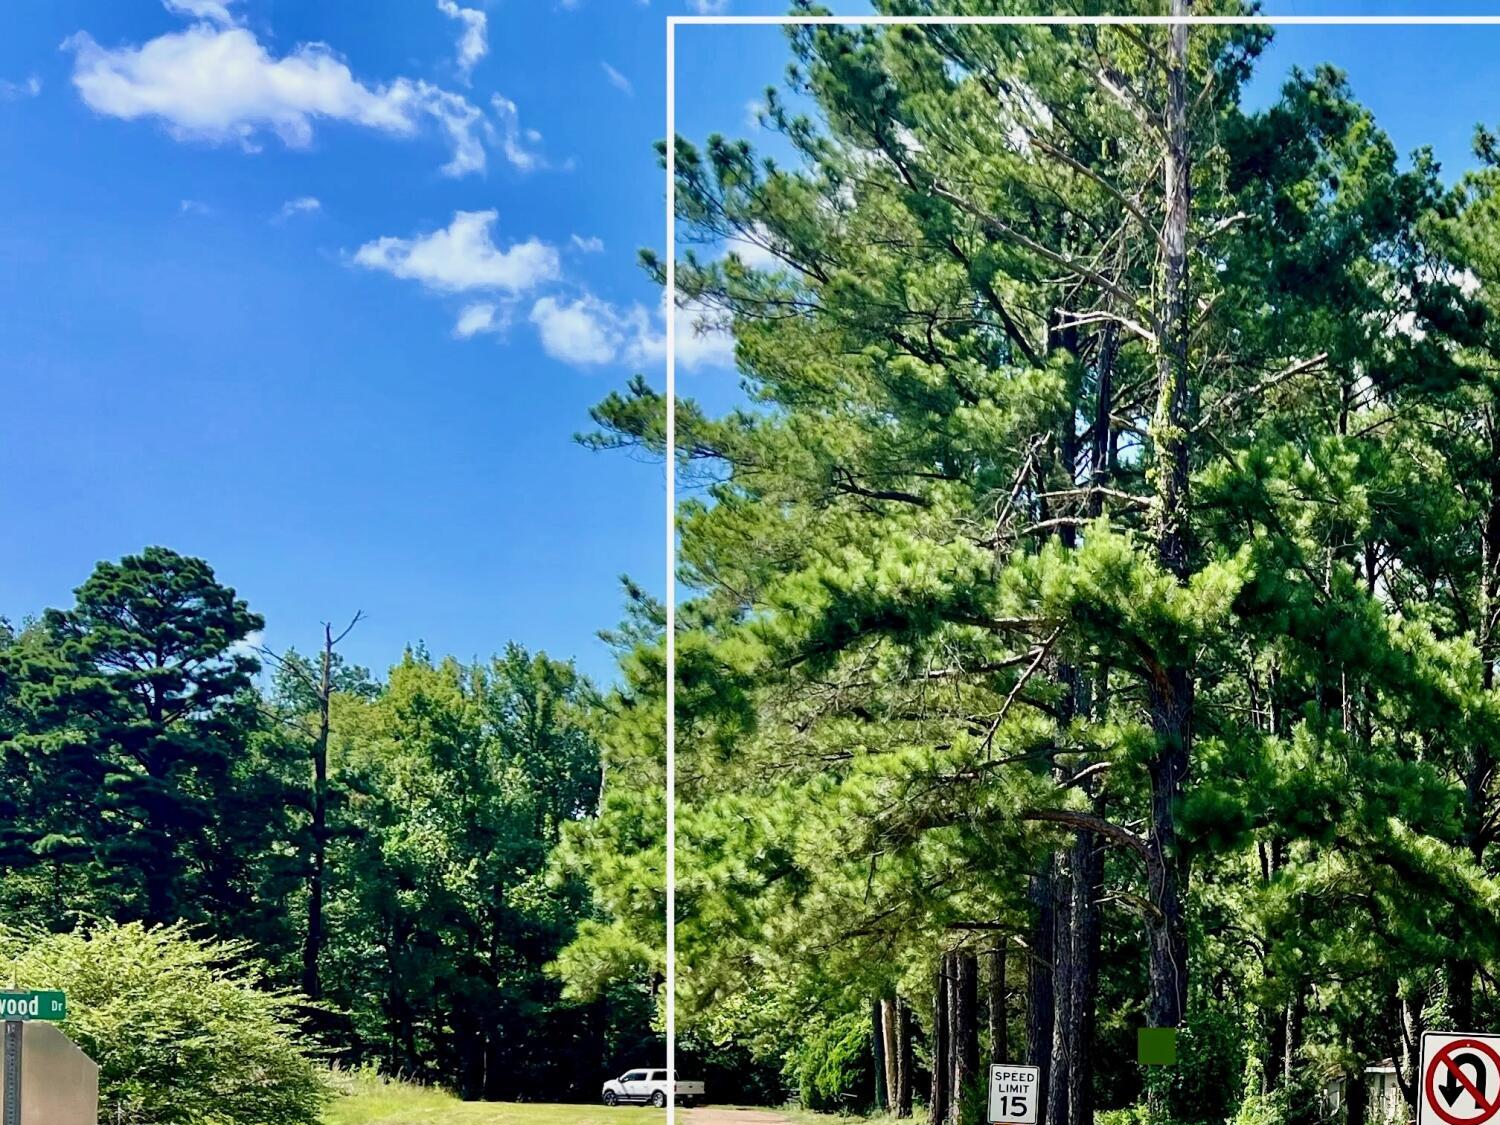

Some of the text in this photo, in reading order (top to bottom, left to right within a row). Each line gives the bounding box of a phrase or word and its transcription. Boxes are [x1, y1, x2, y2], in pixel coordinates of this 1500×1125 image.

[51, 1000, 63, 1011] Dr
[995, 1071, 1034, 1082] SPEED
[998, 1084, 1030, 1093] LIMIT
[1000, 1096, 1028, 1117] 15
